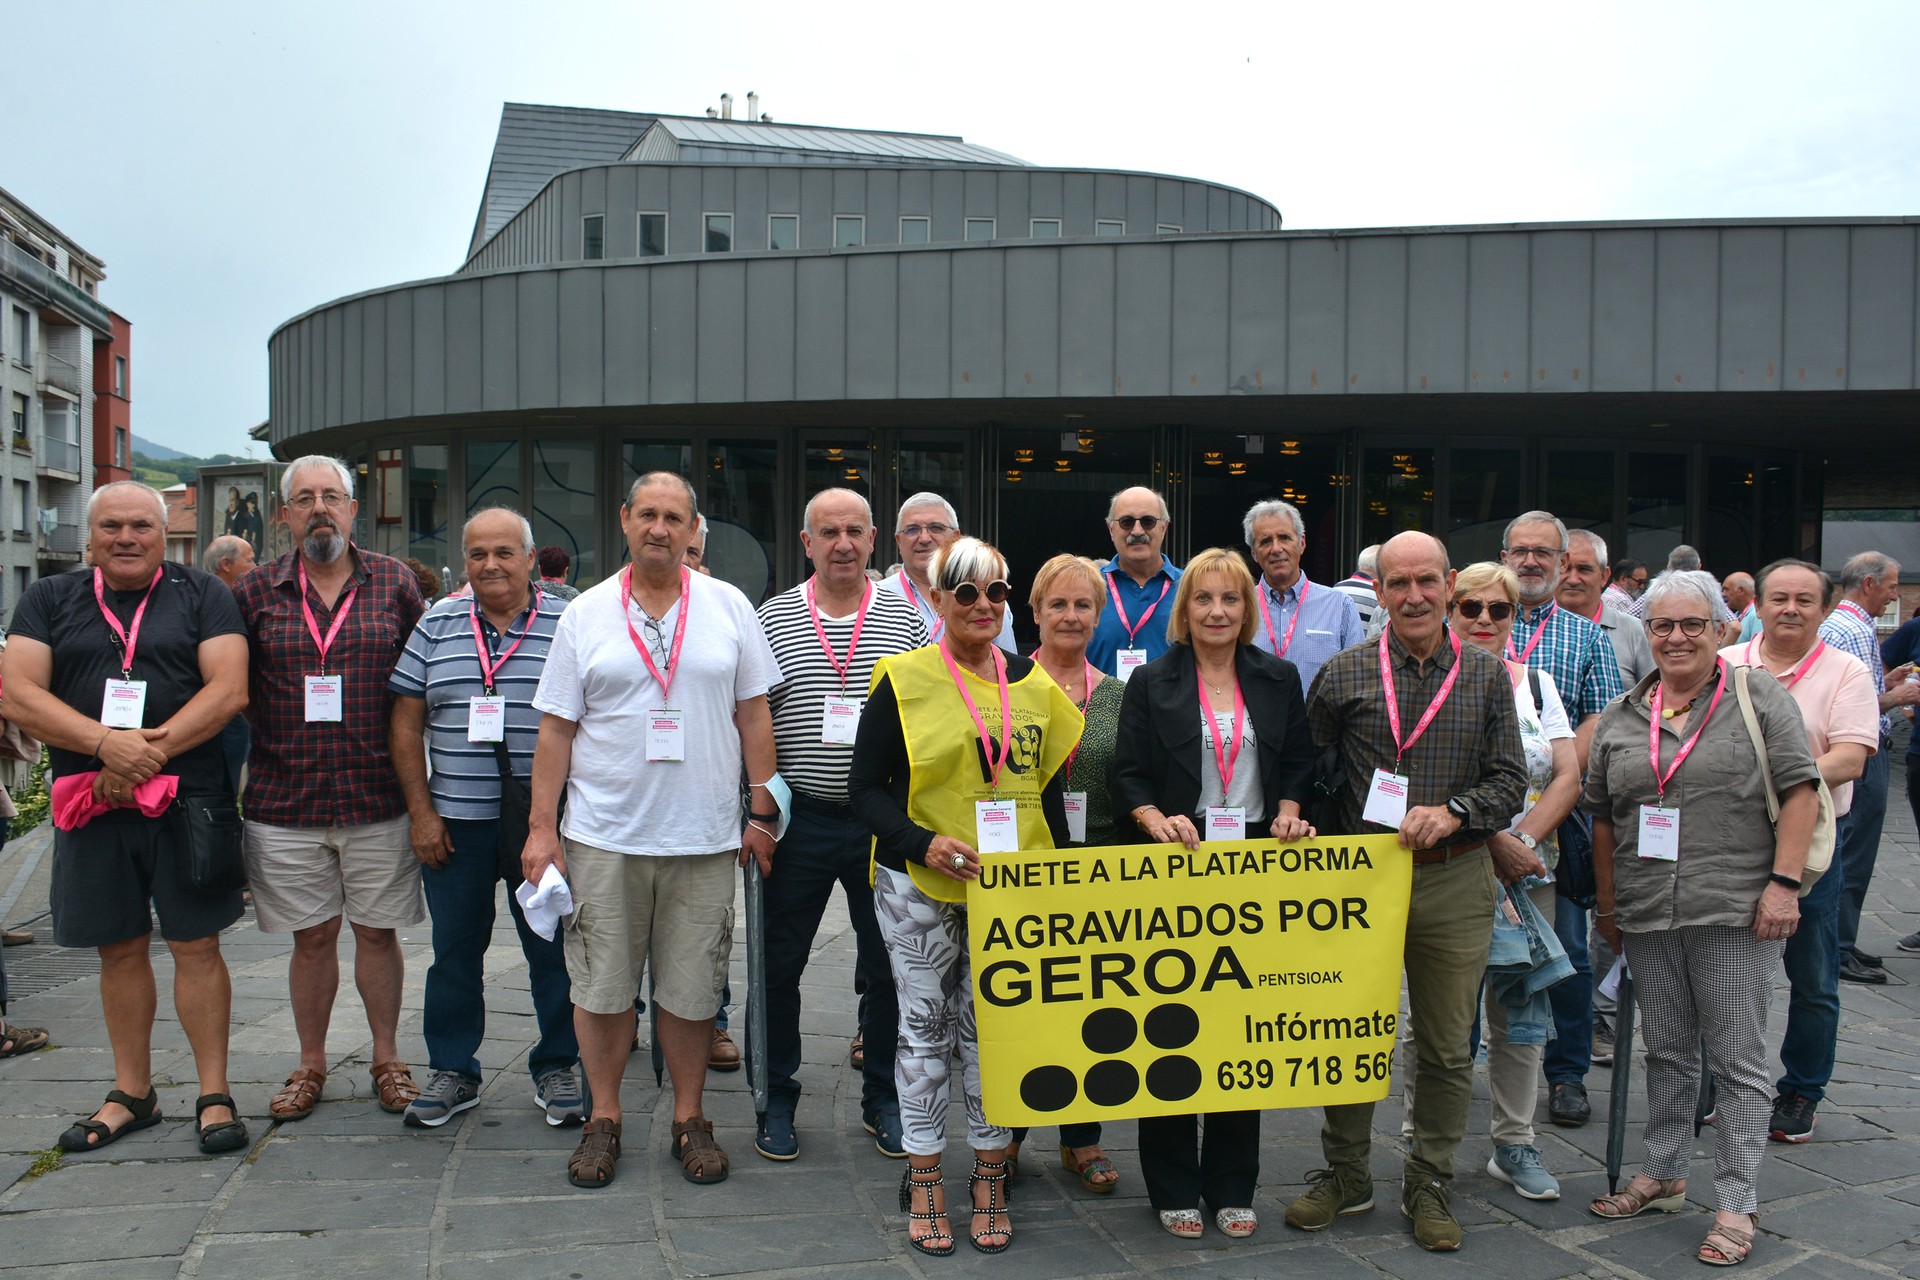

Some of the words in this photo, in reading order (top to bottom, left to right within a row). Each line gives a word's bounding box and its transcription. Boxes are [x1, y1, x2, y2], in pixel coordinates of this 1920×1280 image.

[971, 712, 1034, 723] GRAVADOS
[979, 861, 1081, 890] UNETE
[1089, 858, 1111, 884] A
[1121, 856, 1159, 882] LA
[1168, 846, 1374, 879] PLATAFORMA
[983, 901, 1264, 952] AGRAVIADOS
[1279, 897, 1372, 933] POR
[978, 945, 1254, 1008] GEROA
[1258, 970, 1343, 987] PENTSIOAK
[1245, 1009, 1397, 1043] Infórmate
[1217, 1059, 1274, 1091] 639
[1286, 1055, 1343, 1088] 718
